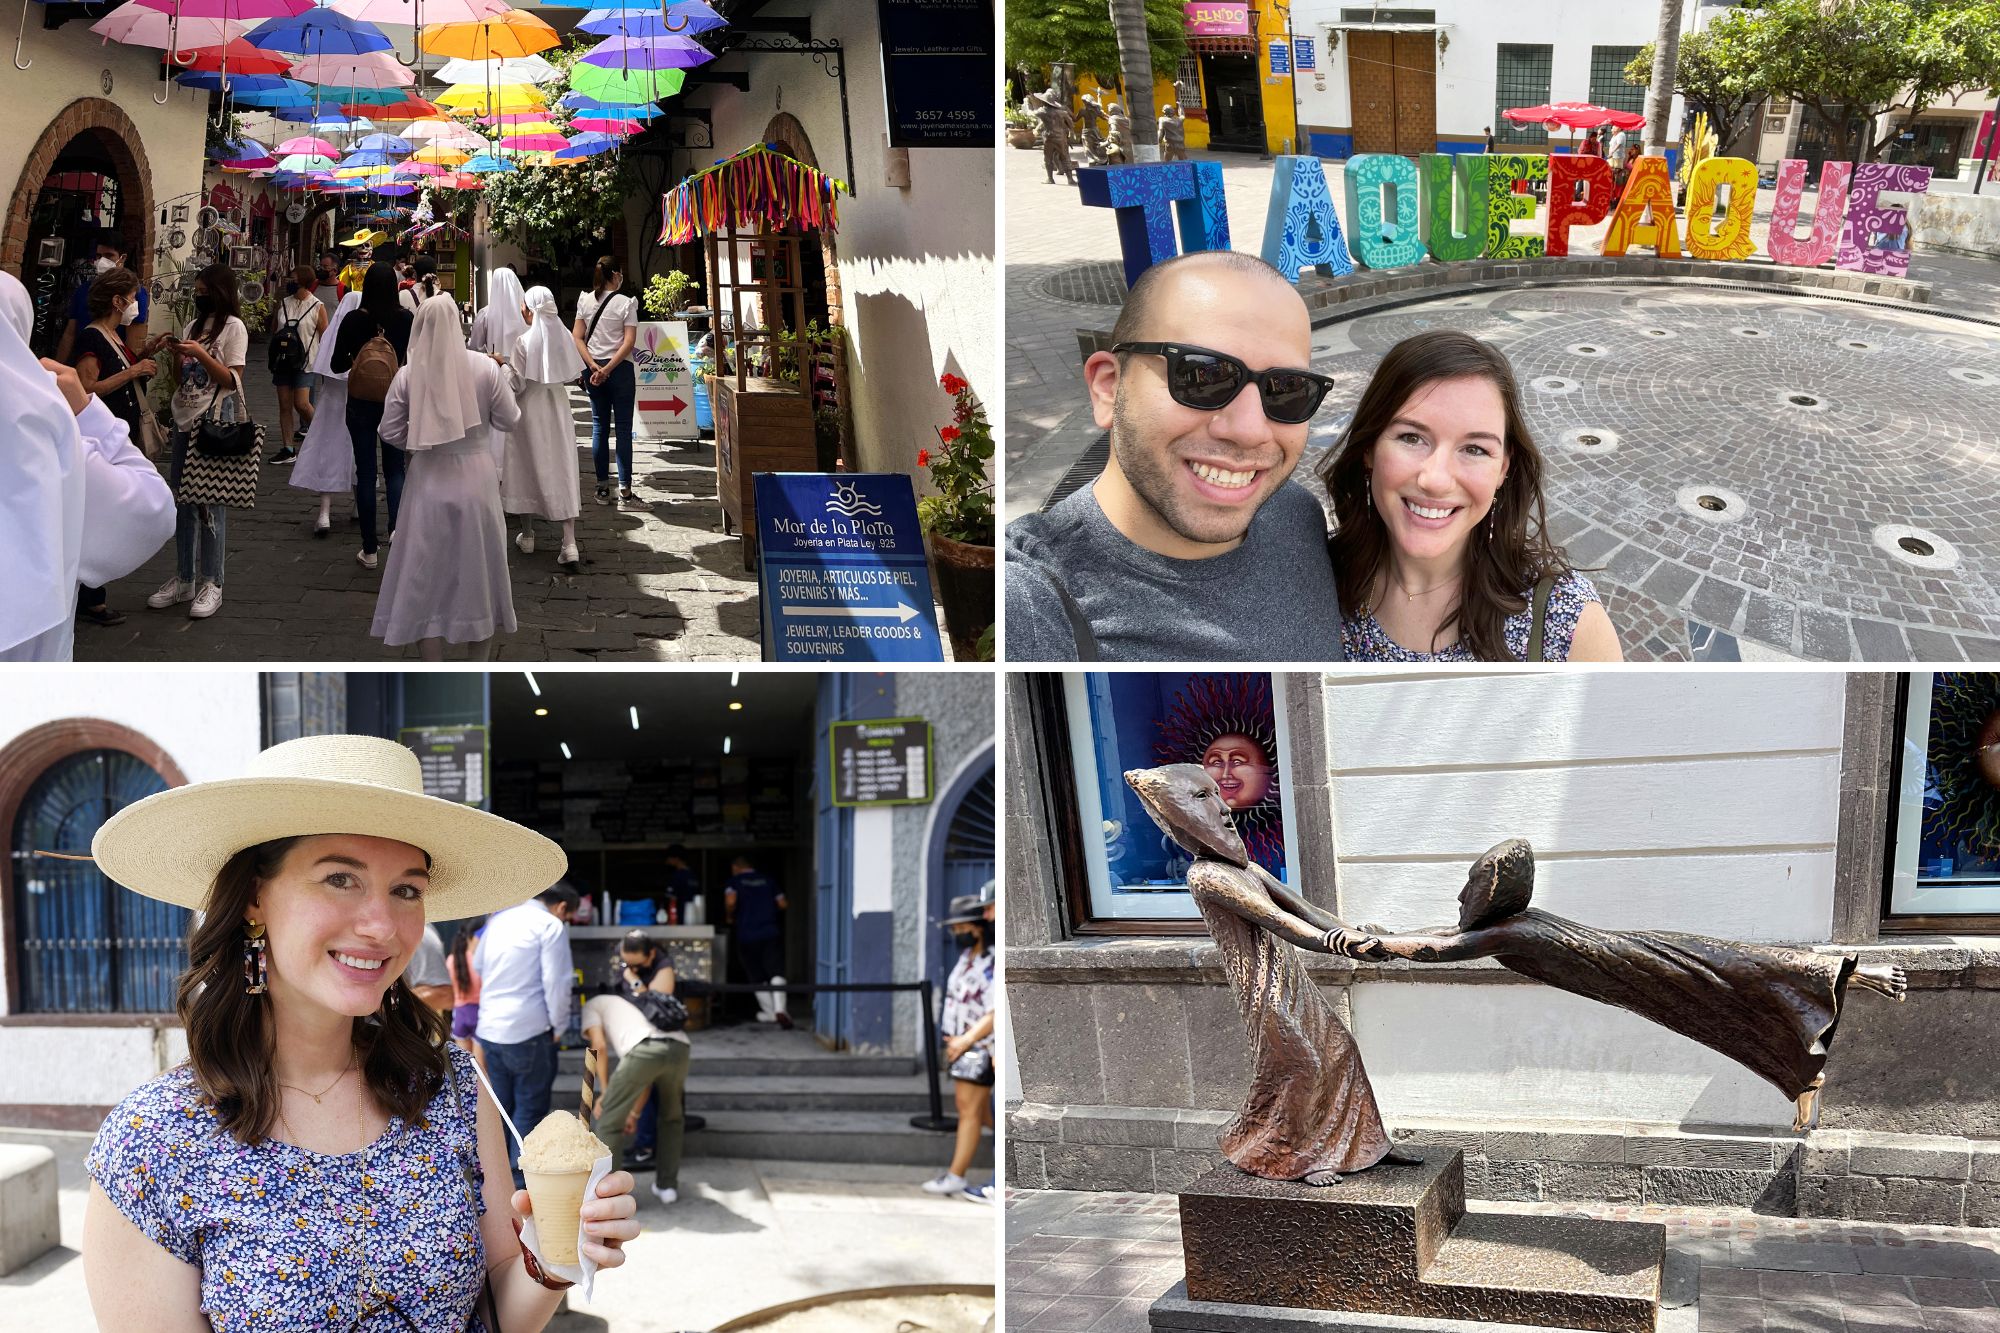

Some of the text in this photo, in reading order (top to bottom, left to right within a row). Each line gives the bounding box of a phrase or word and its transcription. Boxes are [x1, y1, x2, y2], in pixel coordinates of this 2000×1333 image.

[895, 45, 922, 53] Jewelry,
[915, 110, 976, 120] 3657 4595
[636, 350, 684, 366] Rincón
[640, 365, 688, 373] mexicano
[773, 518, 806, 533] Mar
[810, 518, 828, 534] de
[832, 519, 848, 534] la
[825, 539, 836, 547] en
[837, 538, 858, 547] Plata
[860, 538, 876, 549] Ley
[878, 539, 896, 548] .925
[779, 568, 917, 587] JOYERIA, ARTICULOS DE PIEL,
[780, 583, 869, 601] SUVENIRS Y MÁS...
[785, 624, 922, 639] JEWELRY, LEADER GOODS &
[787, 641, 845, 655] SOUVENIRS
